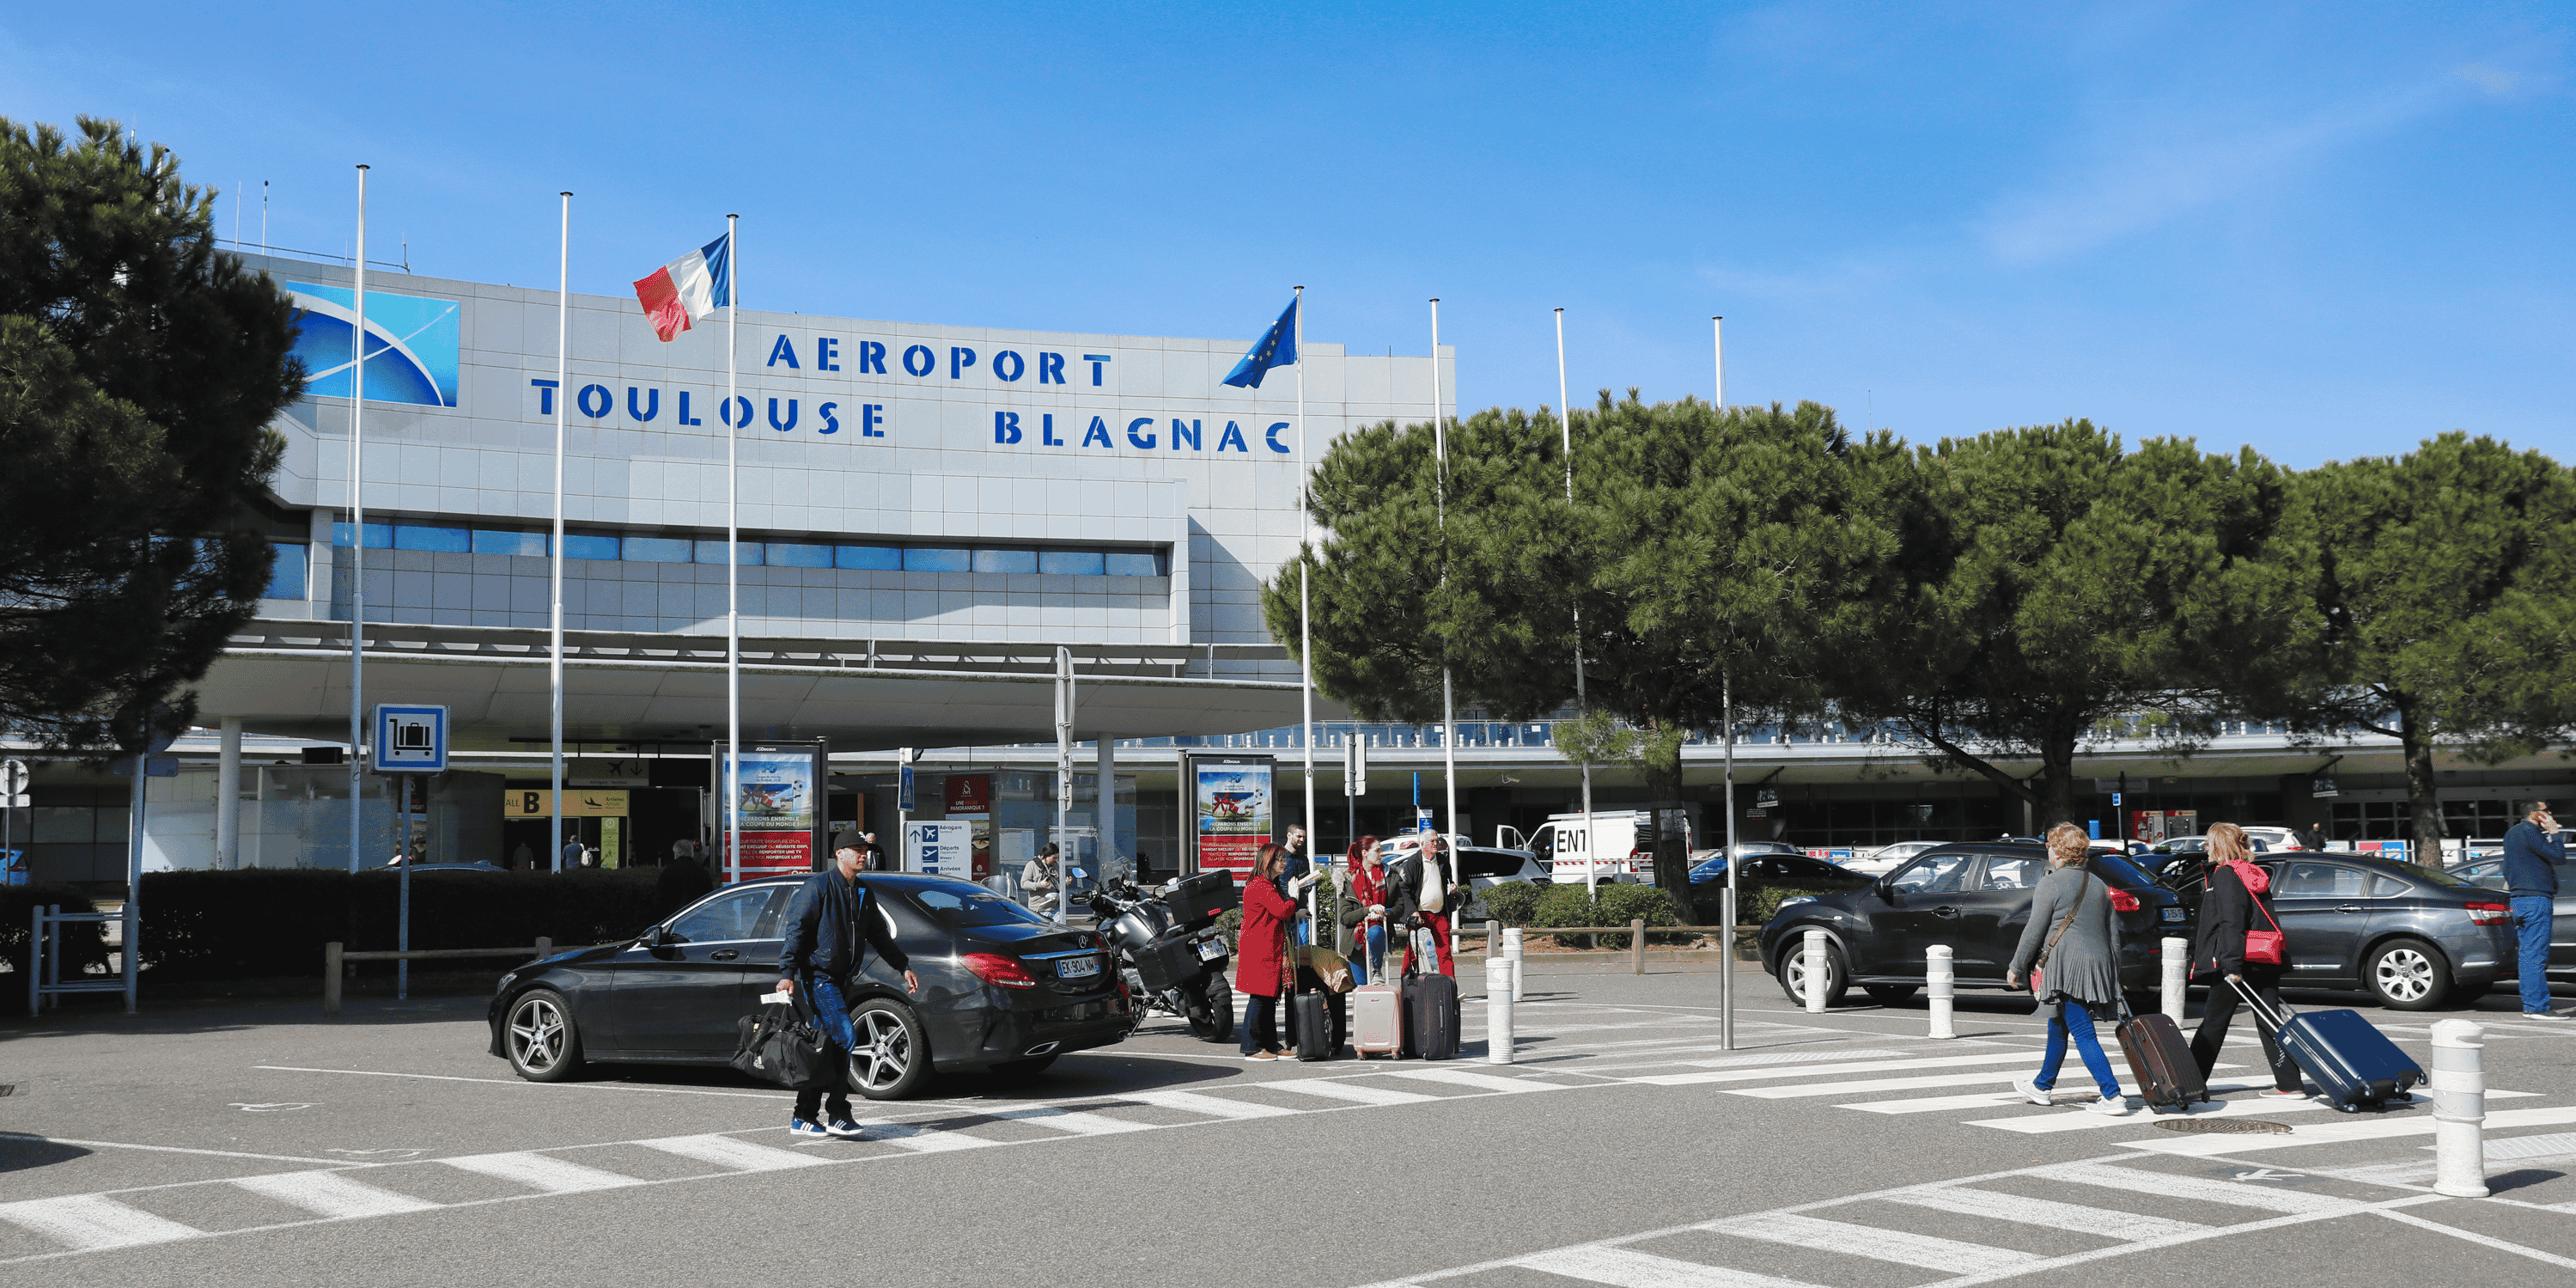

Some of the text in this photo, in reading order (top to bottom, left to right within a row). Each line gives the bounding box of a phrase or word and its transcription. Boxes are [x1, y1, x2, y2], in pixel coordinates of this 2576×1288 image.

[766, 333, 1111, 387] AEROPORT
[531, 378, 1291, 454] TOULOUSE BLAGNAC
[505, 791, 540, 814] ALL B
